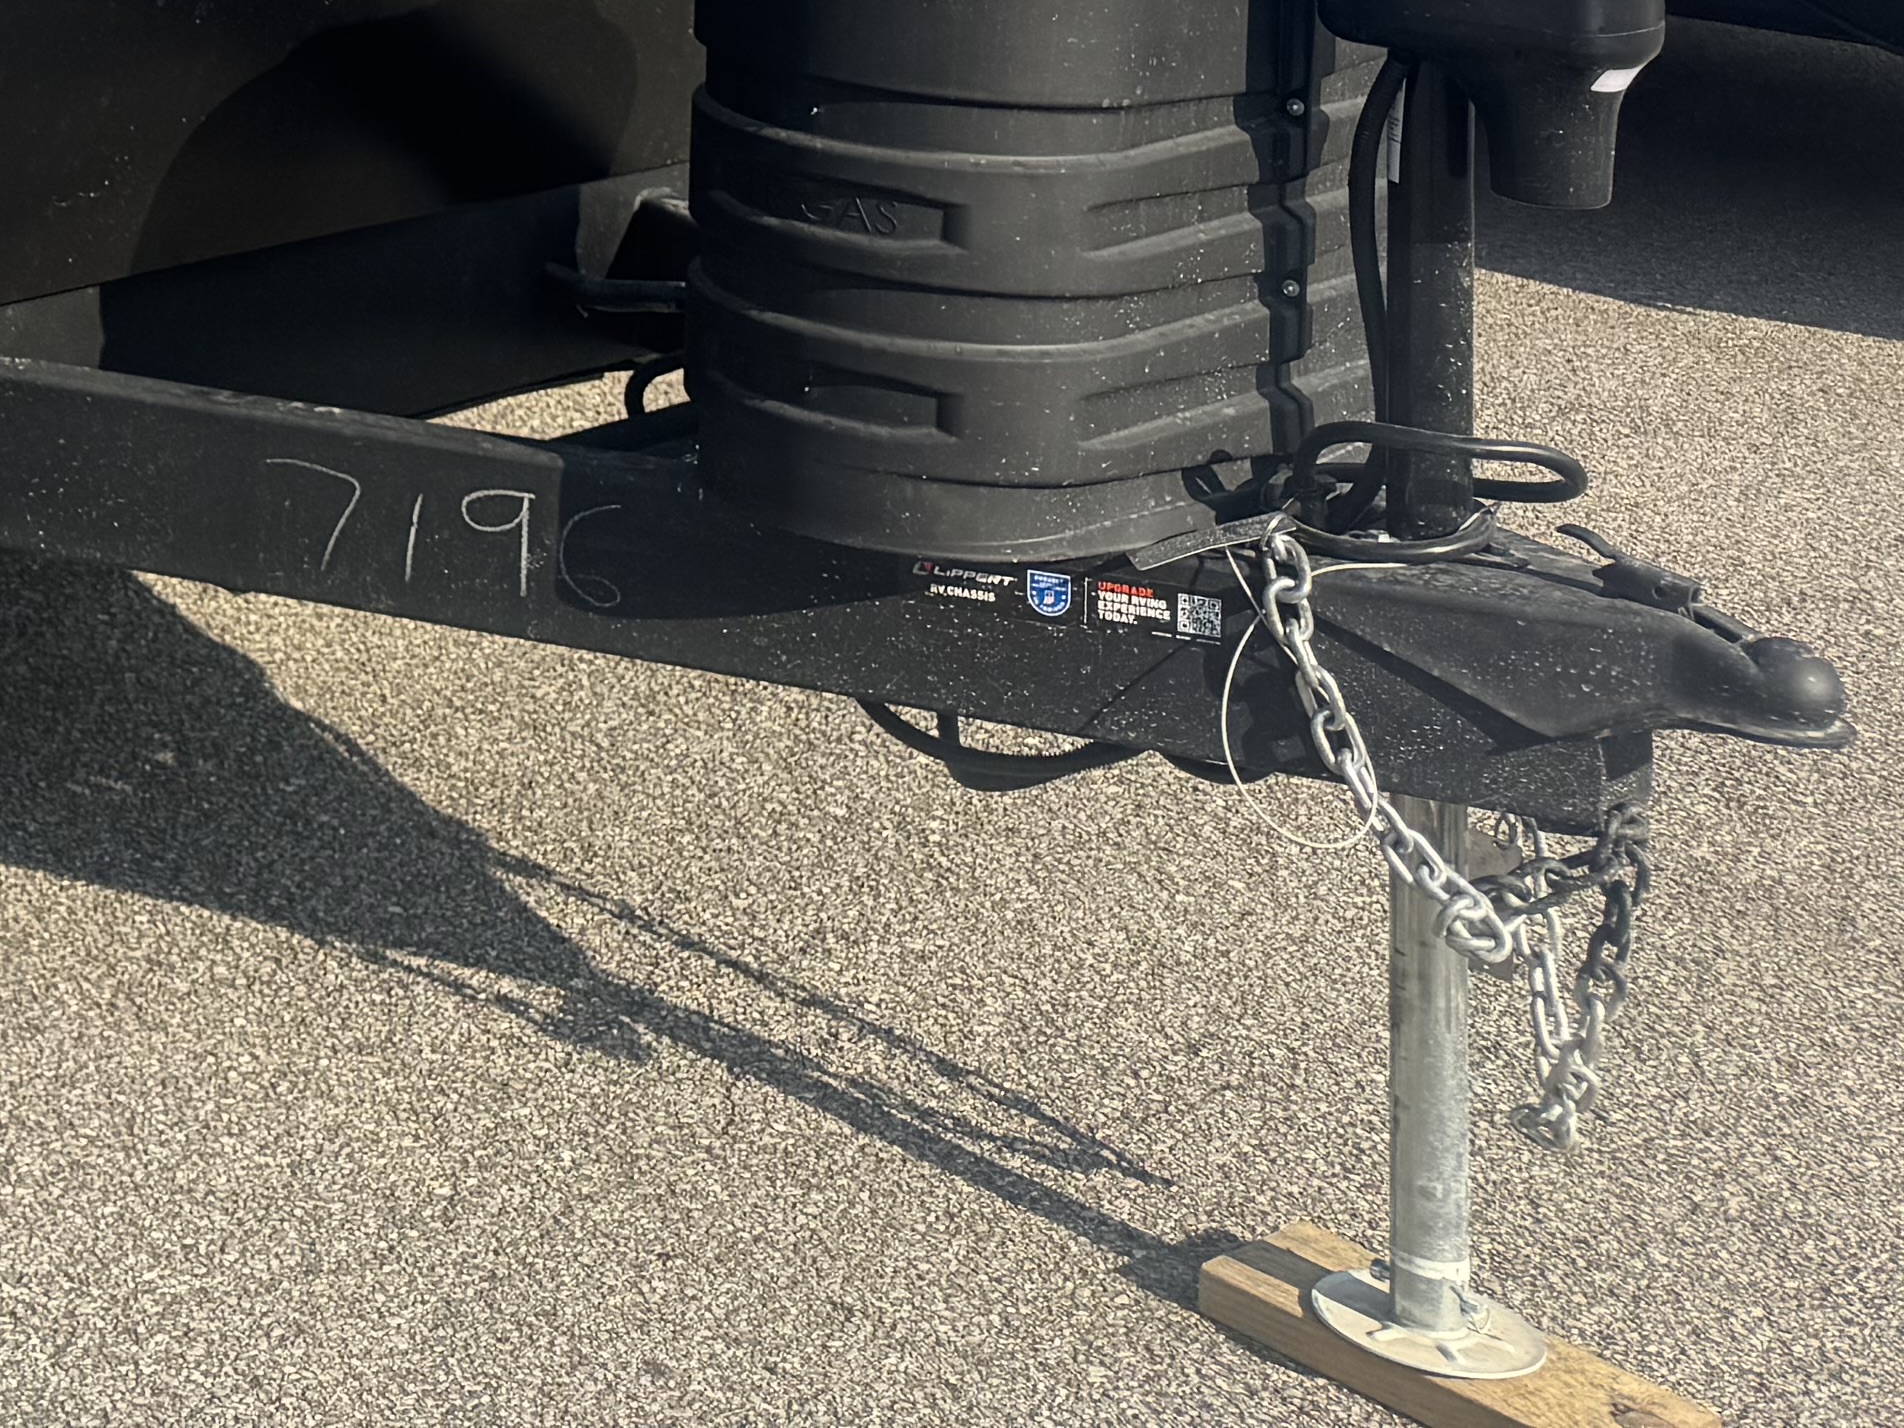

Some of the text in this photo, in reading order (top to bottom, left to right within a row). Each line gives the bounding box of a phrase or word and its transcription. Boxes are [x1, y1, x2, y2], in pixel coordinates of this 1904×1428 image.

[946, 586, 996, 603] CHASSIS
[1097, 581, 1155, 598] UPGRADE
[1097, 590, 1168, 610] YOUR RVING
[1097, 600, 1171, 621] EXPERIENCE
[1097, 609, 1138, 625] TODAY.
